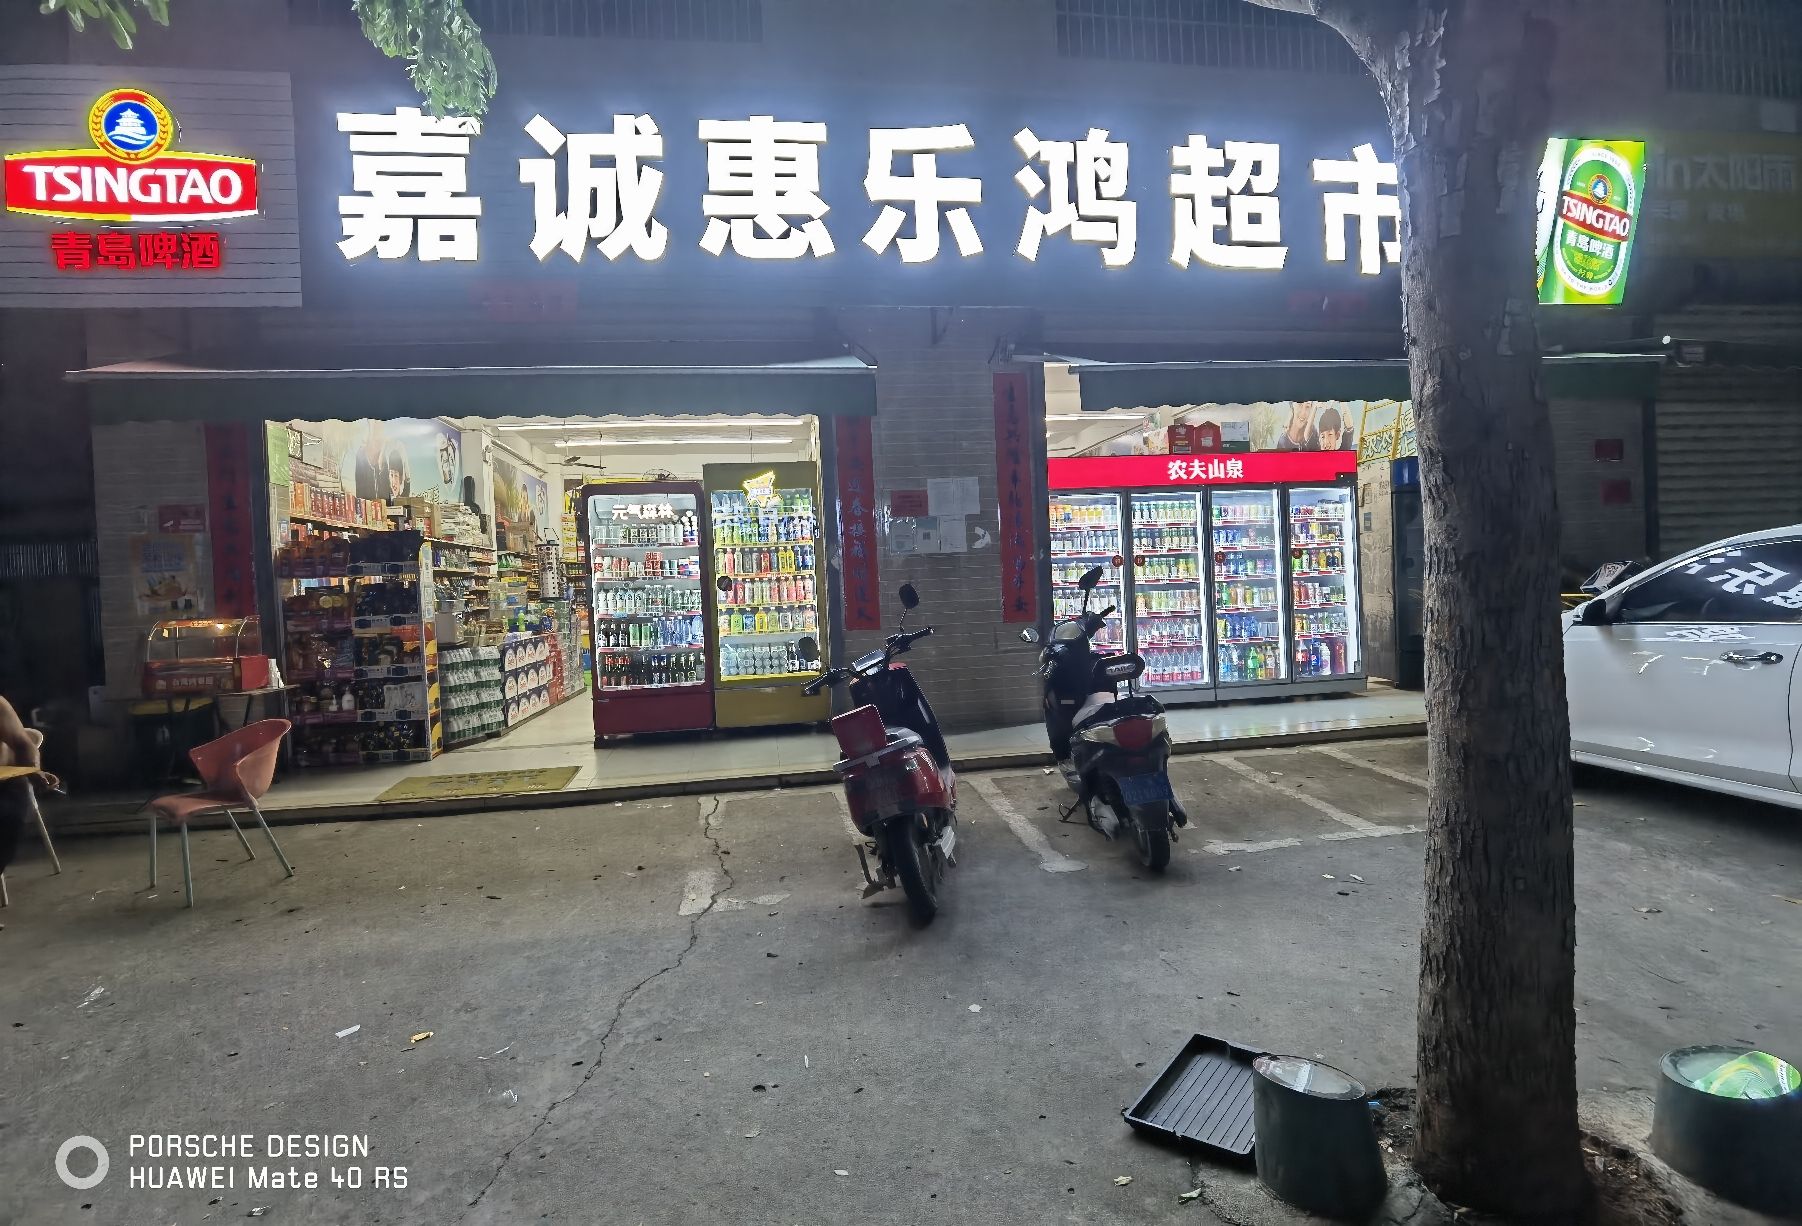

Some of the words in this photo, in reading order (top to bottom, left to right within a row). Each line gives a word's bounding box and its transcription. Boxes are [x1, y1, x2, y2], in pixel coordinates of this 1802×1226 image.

[22, 165, 242, 206] TSINGTAO
[336, 106, 1402, 275] 嘉诚惠乐鸿超市
[1562, 196, 1629, 237] TSINGTAO
[50, 231, 220, 271] 青岛啤酒
[1565, 229, 1615, 260] 青岛啤酒
[1167, 457, 1245, 481] 农夫山泉
[611, 502, 675, 521] 元气森林
